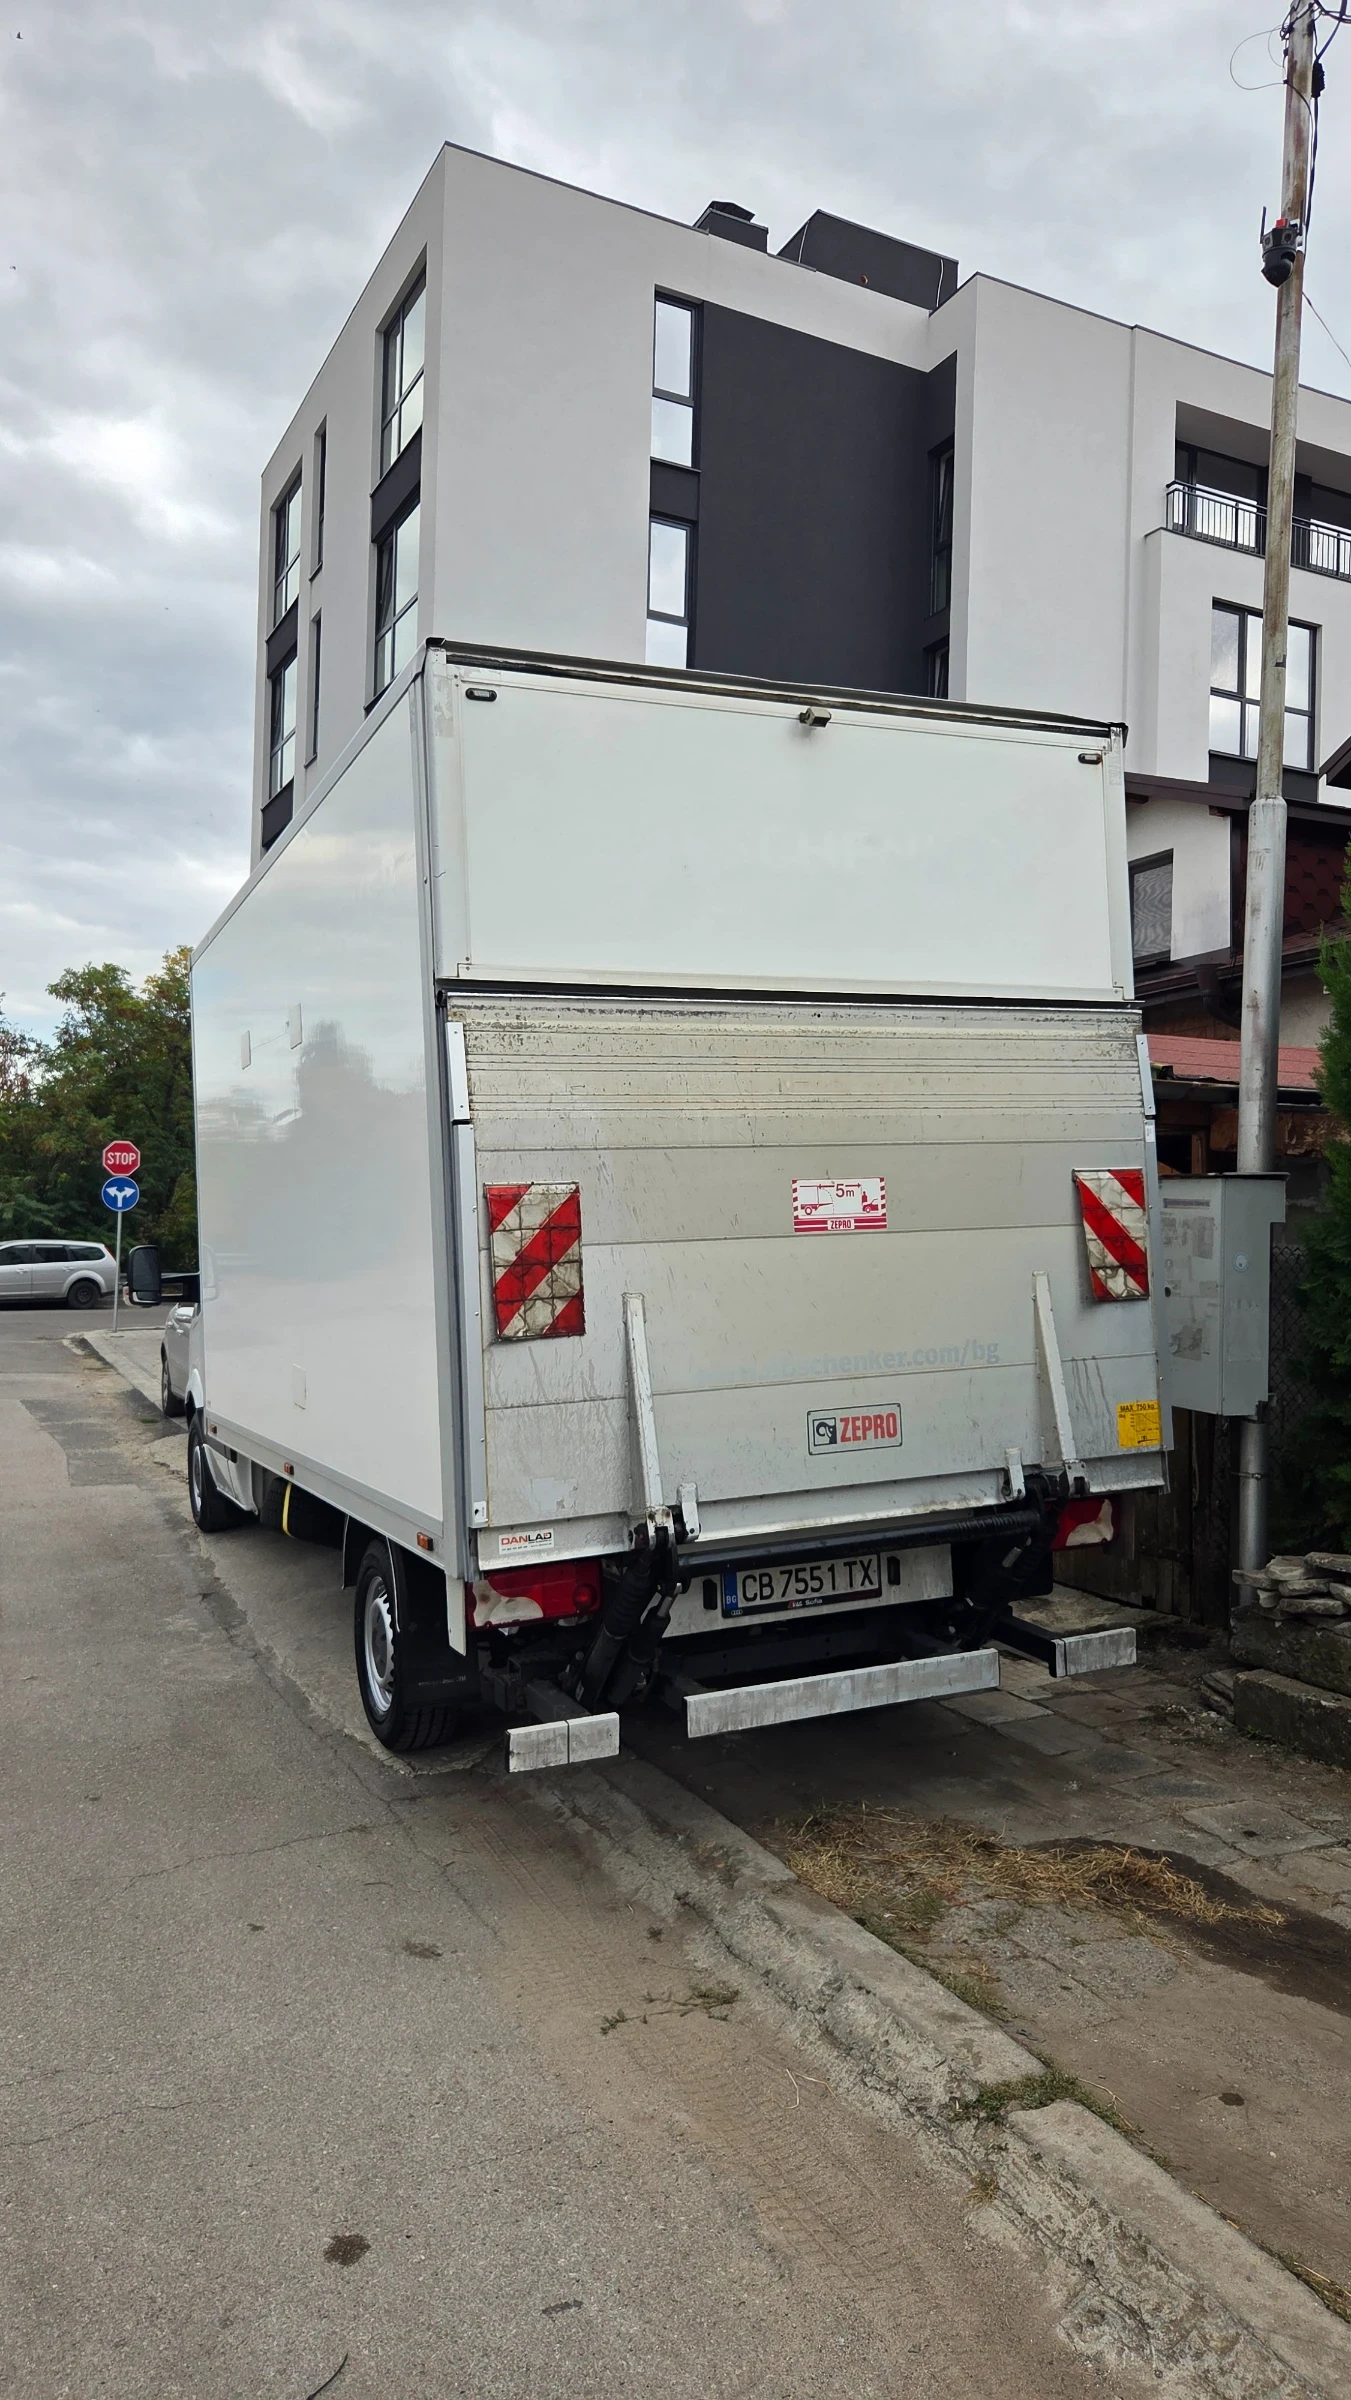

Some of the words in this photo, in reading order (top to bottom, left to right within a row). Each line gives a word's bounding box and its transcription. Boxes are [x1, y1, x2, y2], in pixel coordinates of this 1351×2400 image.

[107, 1152, 136, 1165] STOP
[830, 1220, 852, 1229] ZEPRO
[1120, 1404, 1134, 1412] MAX
[1136, 1403, 1146, 1411] 750
[840, 1412, 898, 1443] ZEPRO
[501, 1532, 552, 1545] DANLAD
[742, 1573, 775, 1602] CB
[779, 1563, 836, 1598] 7551
[843, 1558, 874, 1588] TX
[726, 1594, 737, 1605] BG
